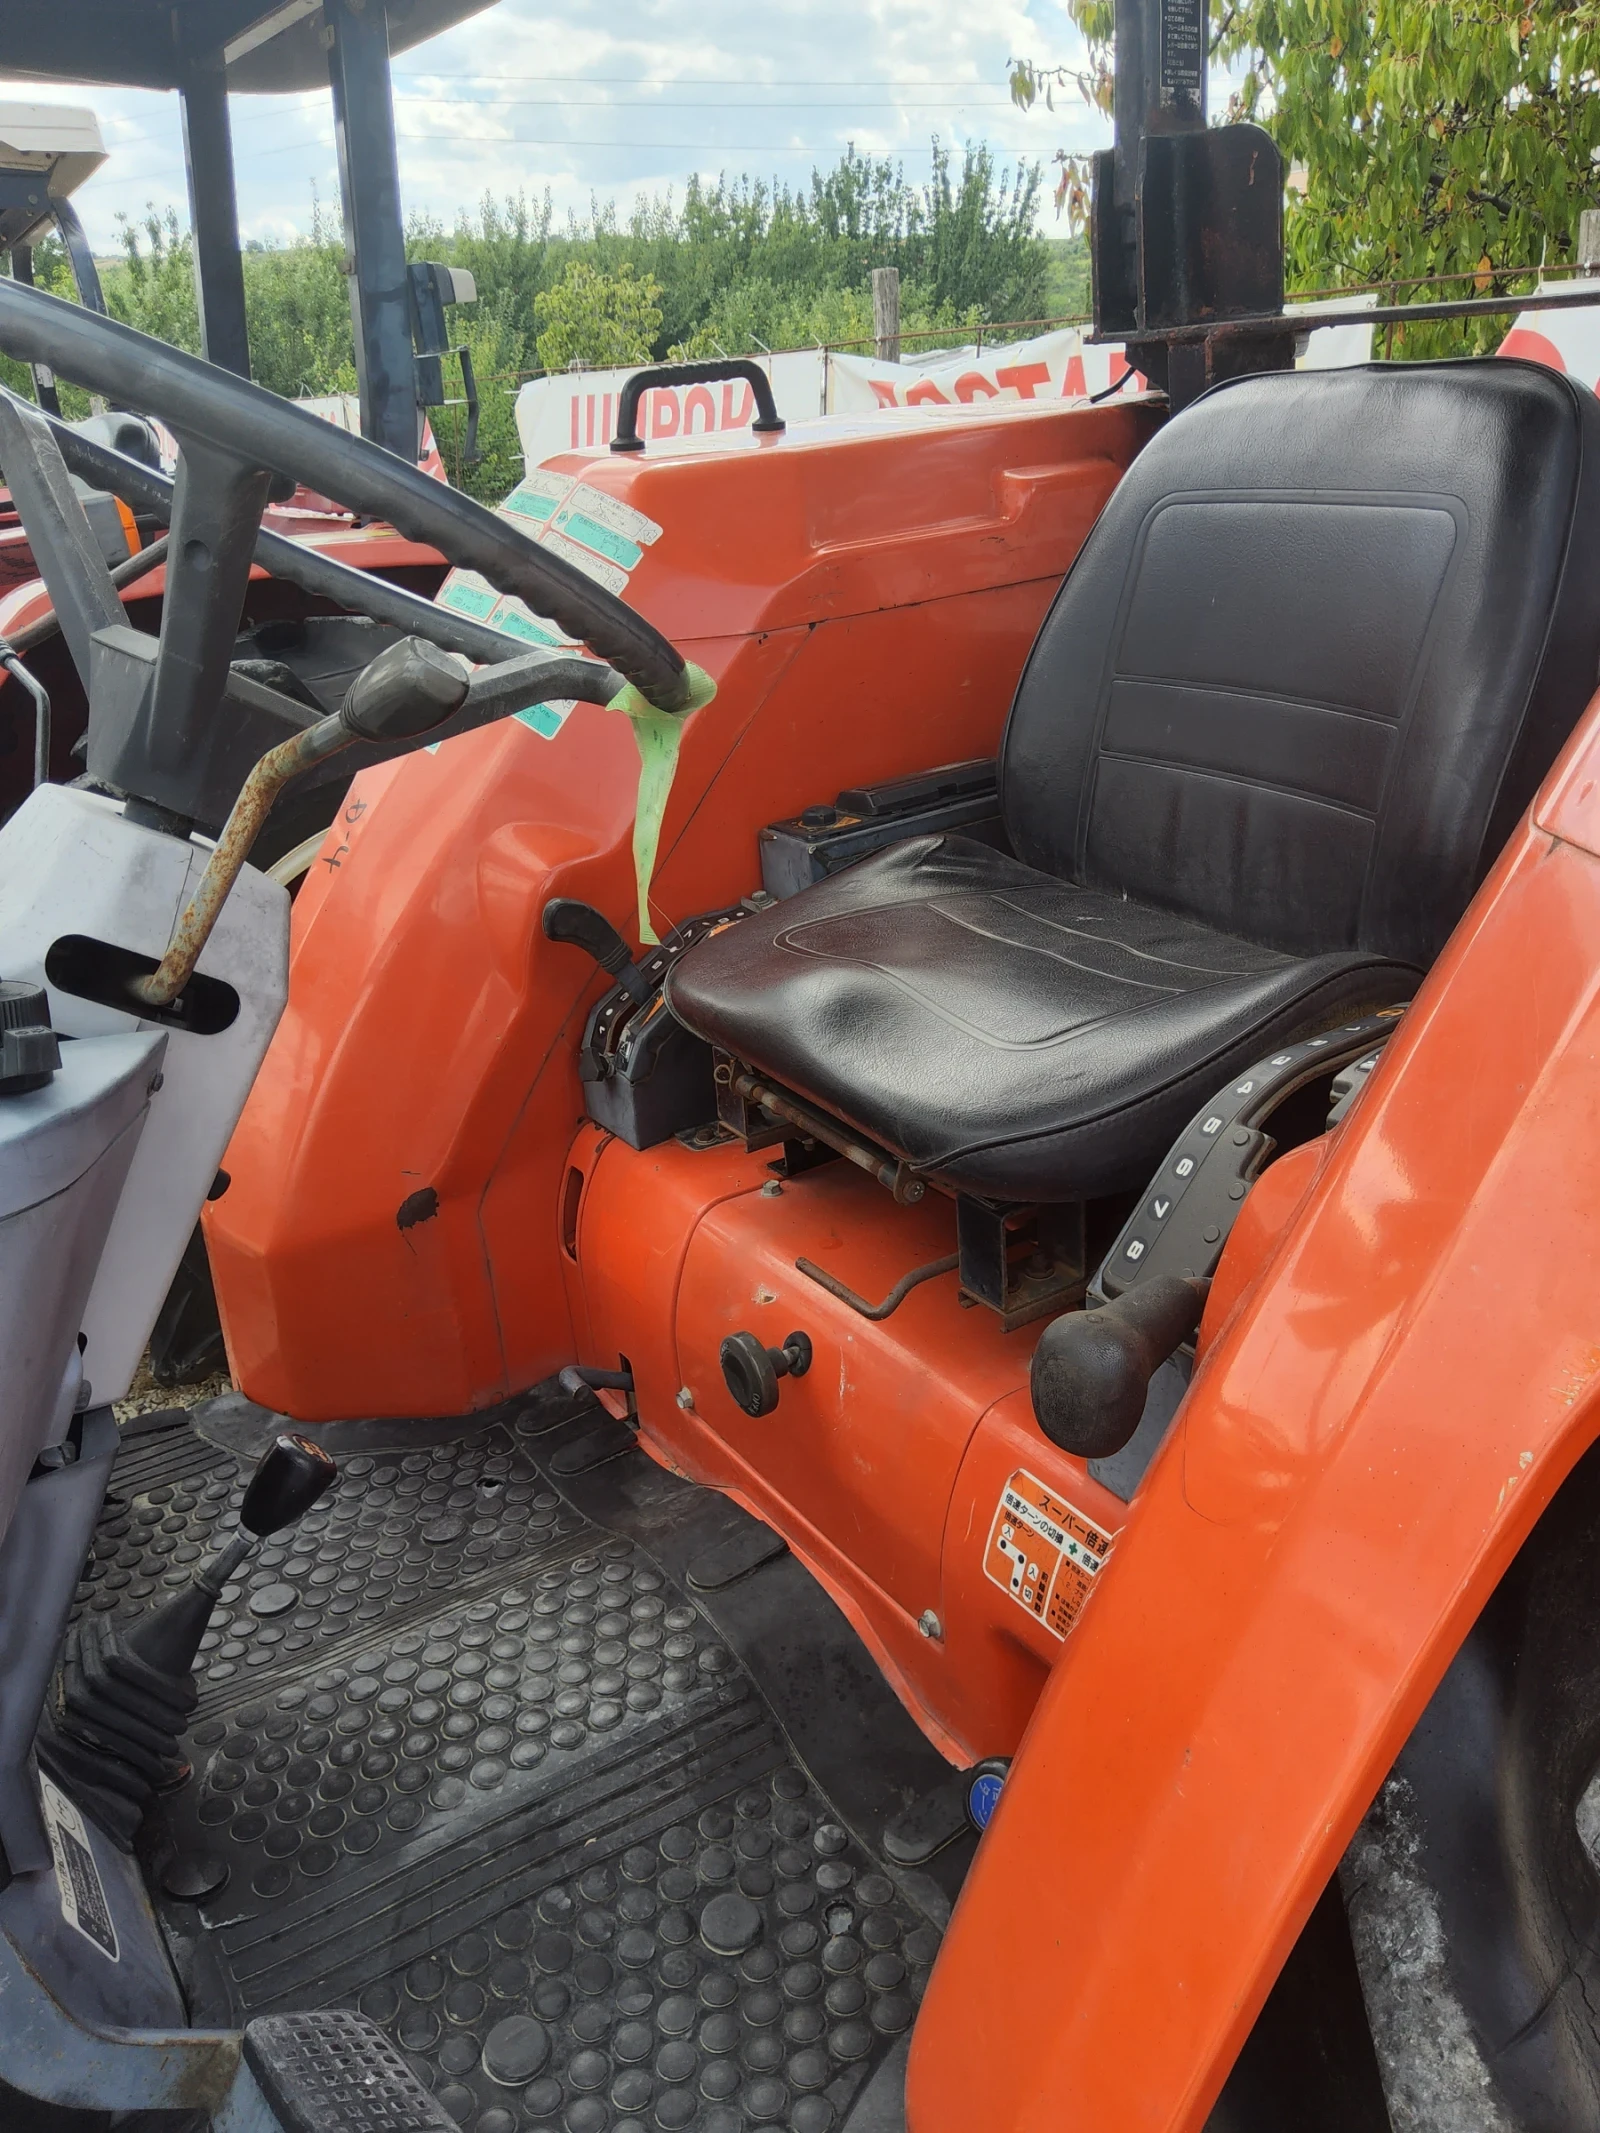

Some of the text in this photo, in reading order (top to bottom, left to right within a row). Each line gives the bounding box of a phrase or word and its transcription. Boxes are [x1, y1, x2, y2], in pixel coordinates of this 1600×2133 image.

[1236, 1081, 1254, 1094] 4
[1202, 1116, 1222, 1134] 5
[1175, 1158, 1194, 1177] 6
[1154, 1199, 1170, 1219] 7
[1126, 1240, 1145, 1260] 8
[1005, 1492, 1064, 1545] 倍速ターンの切換
